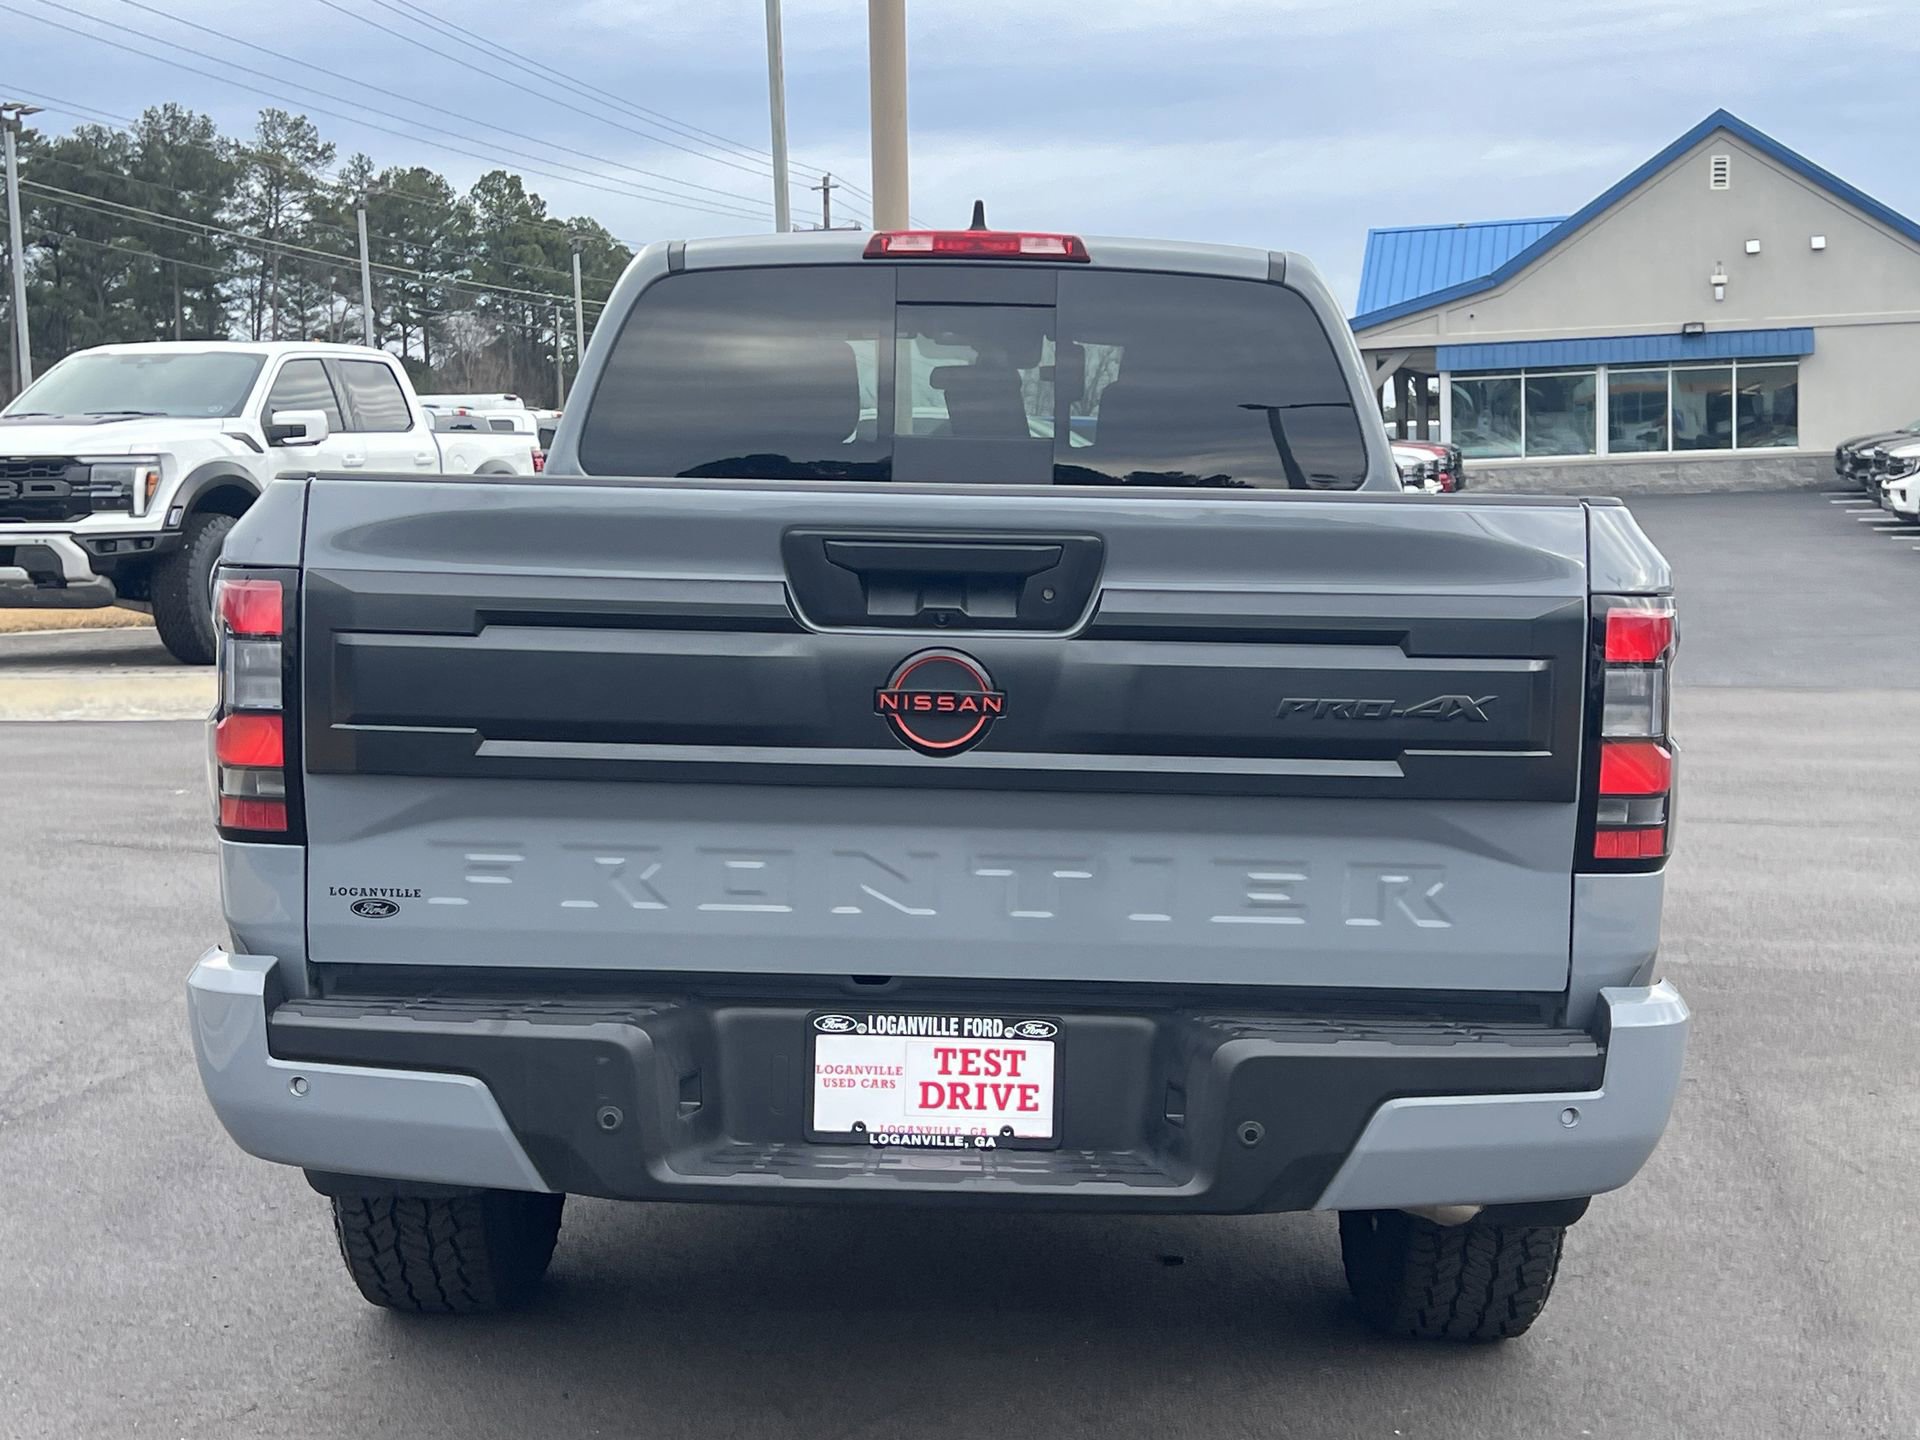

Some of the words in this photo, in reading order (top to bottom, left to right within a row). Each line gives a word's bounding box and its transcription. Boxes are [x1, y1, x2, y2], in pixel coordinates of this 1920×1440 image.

[880, 693, 1002, 712] NISSAN
[1276, 694, 1499, 721] PRO-4X
[329, 886, 422, 898] LOGANVILLE
[427, 839, 1452, 928] FRONTIER
[867, 1014, 959, 1036] LOGANVILLE
[964, 1018, 1003, 1037] FORD
[816, 1064, 904, 1076] LOGANVILLE
[934, 1048, 1026, 1077] TEST
[823, 1077, 856, 1089] USED
[861, 1078, 896, 1089] CARS
[919, 1081, 1039, 1111] DRIVE
[869, 1133, 969, 1149] LOGANVILLE,
[974, 1136, 997, 1148] GA
